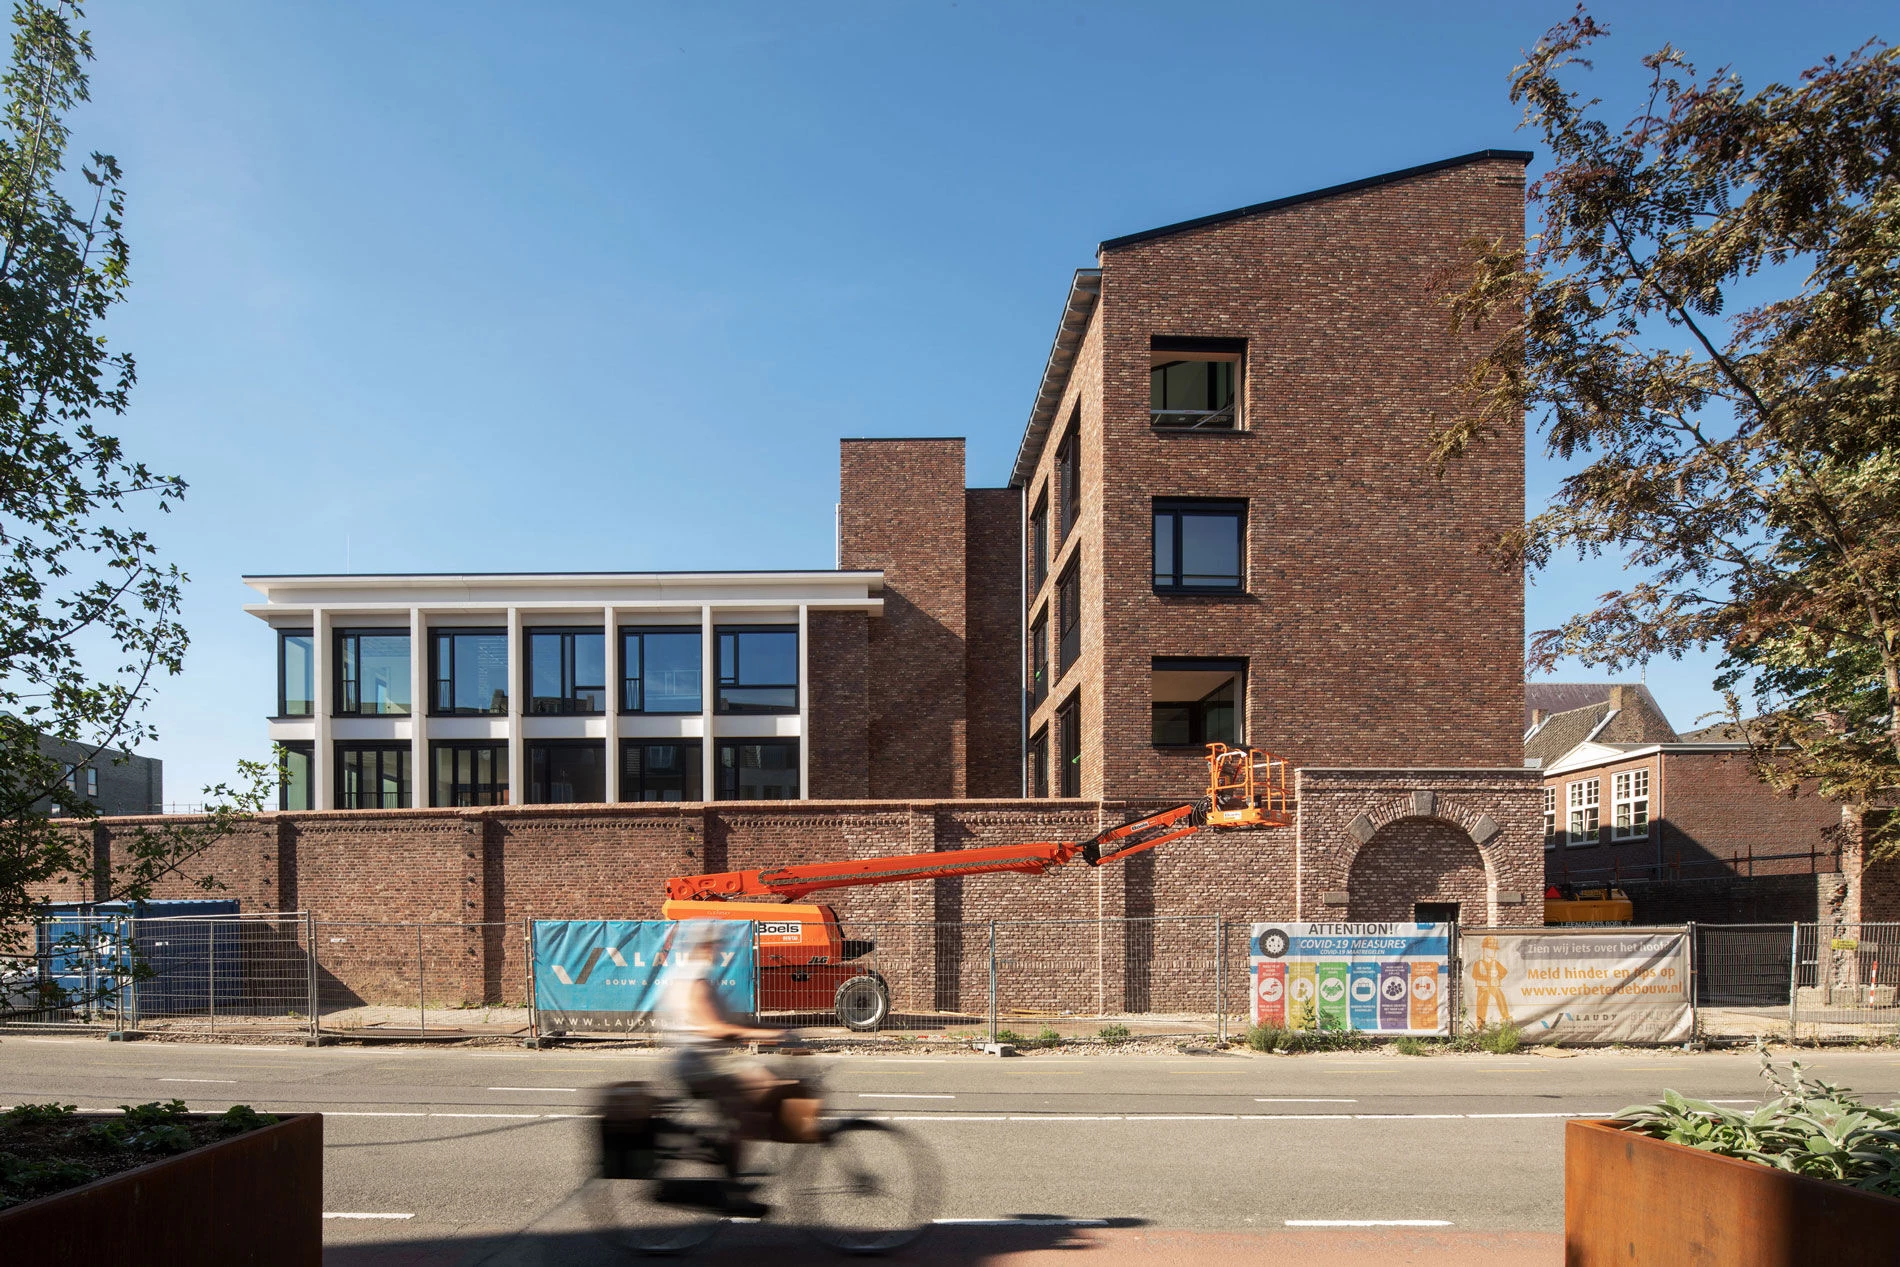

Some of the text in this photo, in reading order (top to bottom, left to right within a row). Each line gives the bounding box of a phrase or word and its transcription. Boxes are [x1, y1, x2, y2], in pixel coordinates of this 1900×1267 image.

[756, 922, 799, 933] Boels
[1308, 923, 1394, 935] ATTENTION!
[1300, 939, 1406, 949] COVID-19 MEASURES
[1528, 943, 1550, 954] Zien
[1553, 943, 1569, 956] wij
[1572, 942, 1591, 953] iets
[1594, 944, 1618, 953] over
[1620, 942, 1637, 953] het
[634, 952, 735, 967] LAUY
[808, 956, 829, 964] JLG
[1527, 967, 1676, 981] Meld hinder en tips op
[1520, 981, 1683, 997] www.verbeterdebouw.nl
